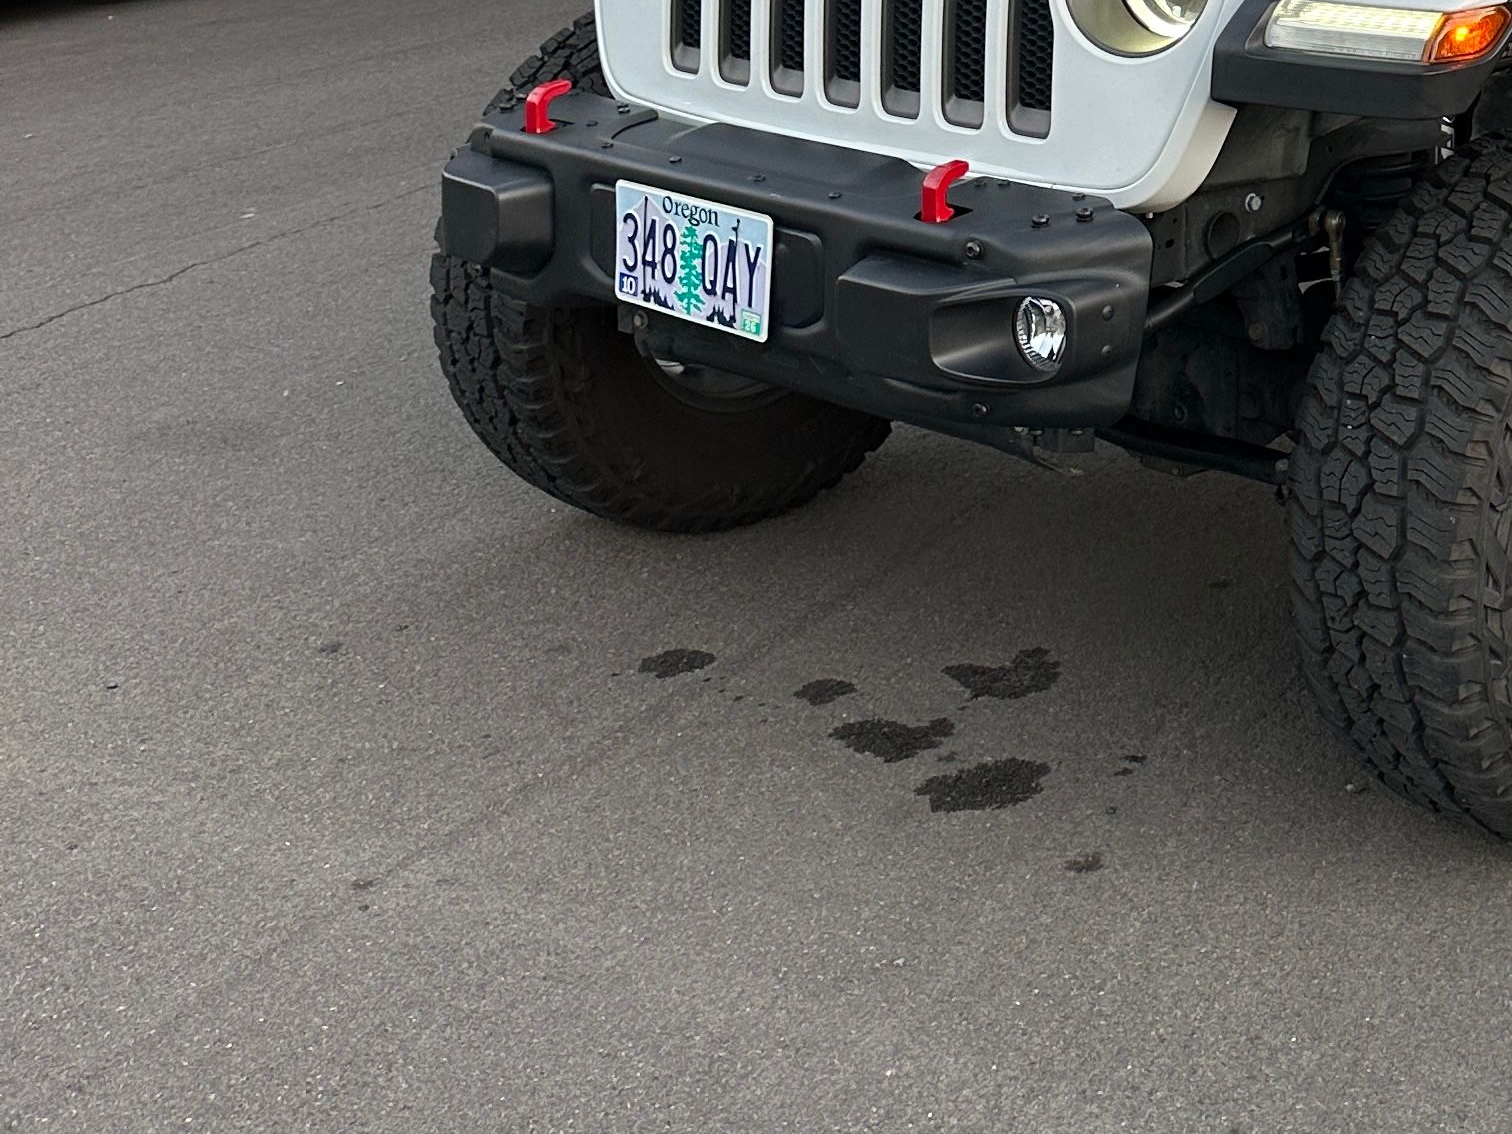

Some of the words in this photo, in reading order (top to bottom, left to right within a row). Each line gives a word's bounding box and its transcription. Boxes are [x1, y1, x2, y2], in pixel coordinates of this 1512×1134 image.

[662, 195, 720, 227] Oregon
[622, 212, 677, 284] 348
[701, 233, 762, 308] QAY
[621, 276, 637, 296] 10
[744, 319, 757, 333] 26
